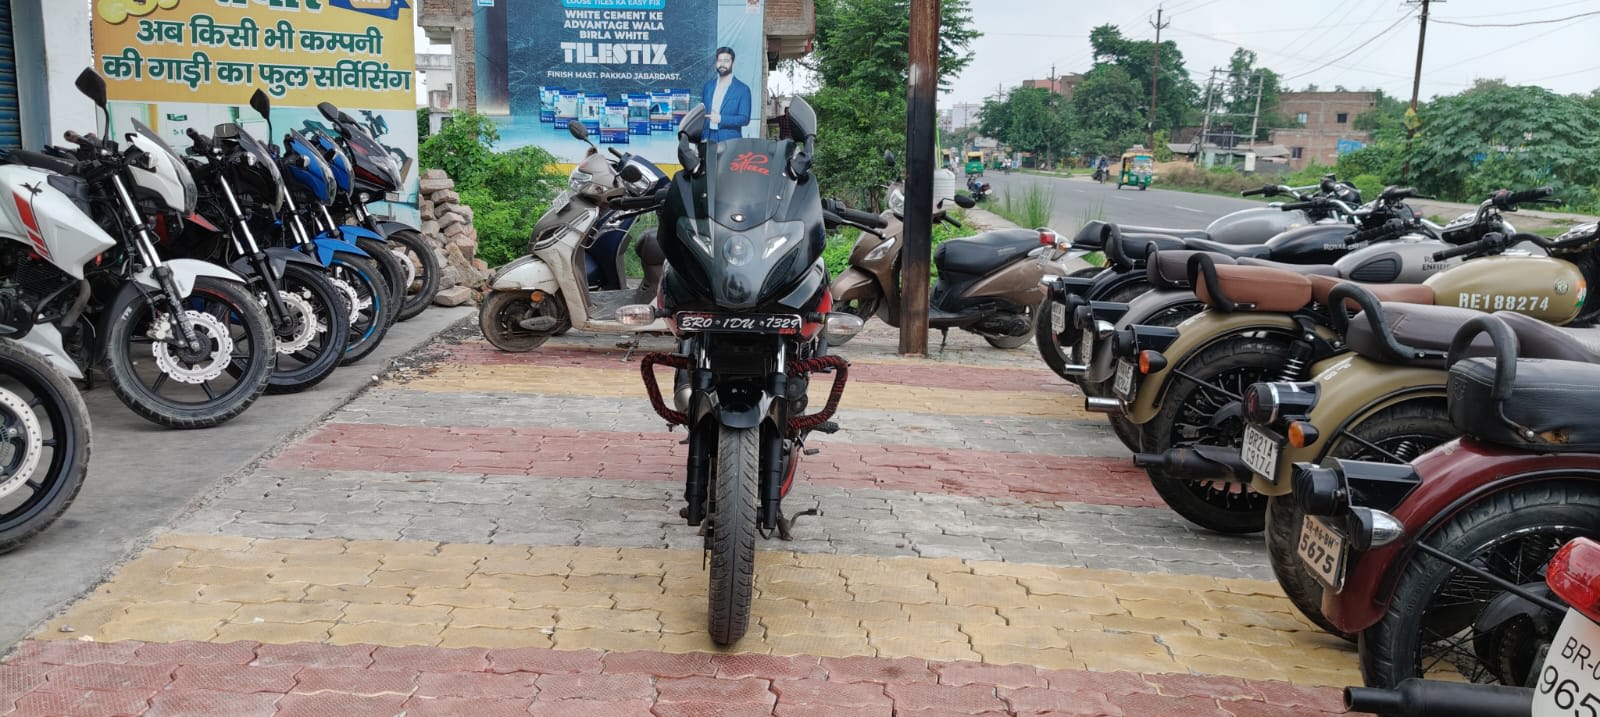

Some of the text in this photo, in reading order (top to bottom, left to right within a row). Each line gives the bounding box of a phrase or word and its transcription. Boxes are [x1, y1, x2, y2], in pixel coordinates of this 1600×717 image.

[565, 10, 664, 20] WHITE CEMENT KE
[564, 20, 665, 31] ADVANTAGE WALA
[137, 15, 383, 55] अब किसी भी कम्पनी
[579, 30, 649, 40] BIRLA WHITE
[560, 42, 668, 66] TILESTIX
[103, 48, 411, 95] की गाड़ी का फुल सर्विसिंग
[547, 70, 682, 81] FINISH MAST. PAKKAD JABARDAST.
[1323, 242, 1346, 251] ROYAL
[1459, 293, 1549, 311] RE188274
[766, 316, 800, 329] 7329
[1300, 533, 1335, 574] 5675
